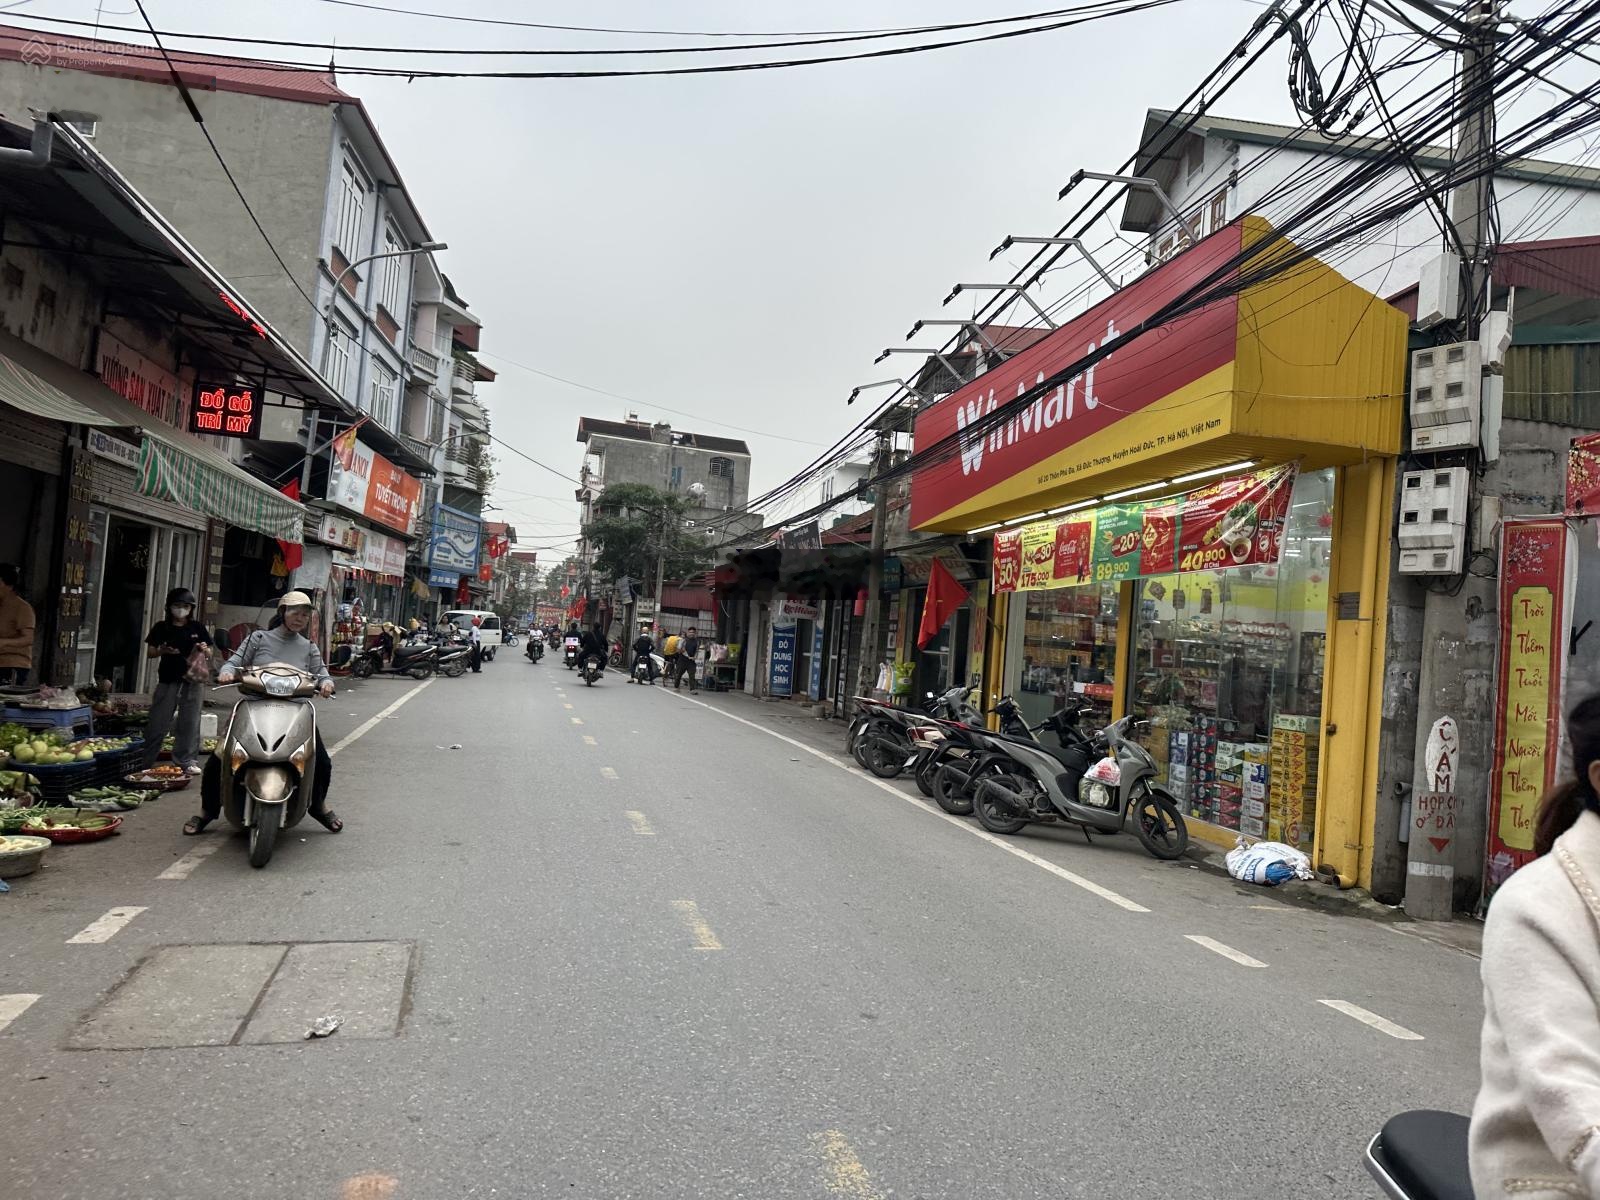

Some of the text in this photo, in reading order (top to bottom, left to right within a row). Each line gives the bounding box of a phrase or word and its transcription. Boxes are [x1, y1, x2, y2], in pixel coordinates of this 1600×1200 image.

[228, 391, 253, 412] GỖ
[197, 411, 252, 433] TRÍ MỸ
[1083, 460, 1092, 471] Đức
[1112, 449, 1129, 461] Huyện
[1143, 440, 1156, 451] Đức,
[1157, 436, 1166, 447] TP.
[1167, 433, 1176, 443] Hà
[1176, 429, 1190, 441] Nội,
[1190, 424, 1204, 436] Việt
[1205, 418, 1221, 430] Nam
[1180, 548, 1226, 570] 40.900
[1520, 599, 1545, 620] Trời
[1516, 630, 1545, 656] Thêm
[773, 676, 789, 684] SINH
[1515, 667, 1543, 689] Tuổi
[1515, 702, 1538, 723] Mới
[1435, 720, 1456, 793] CẤM
[1507, 763, 1537, 796] Thêm
[1510, 804, 1530, 830] Thọ
